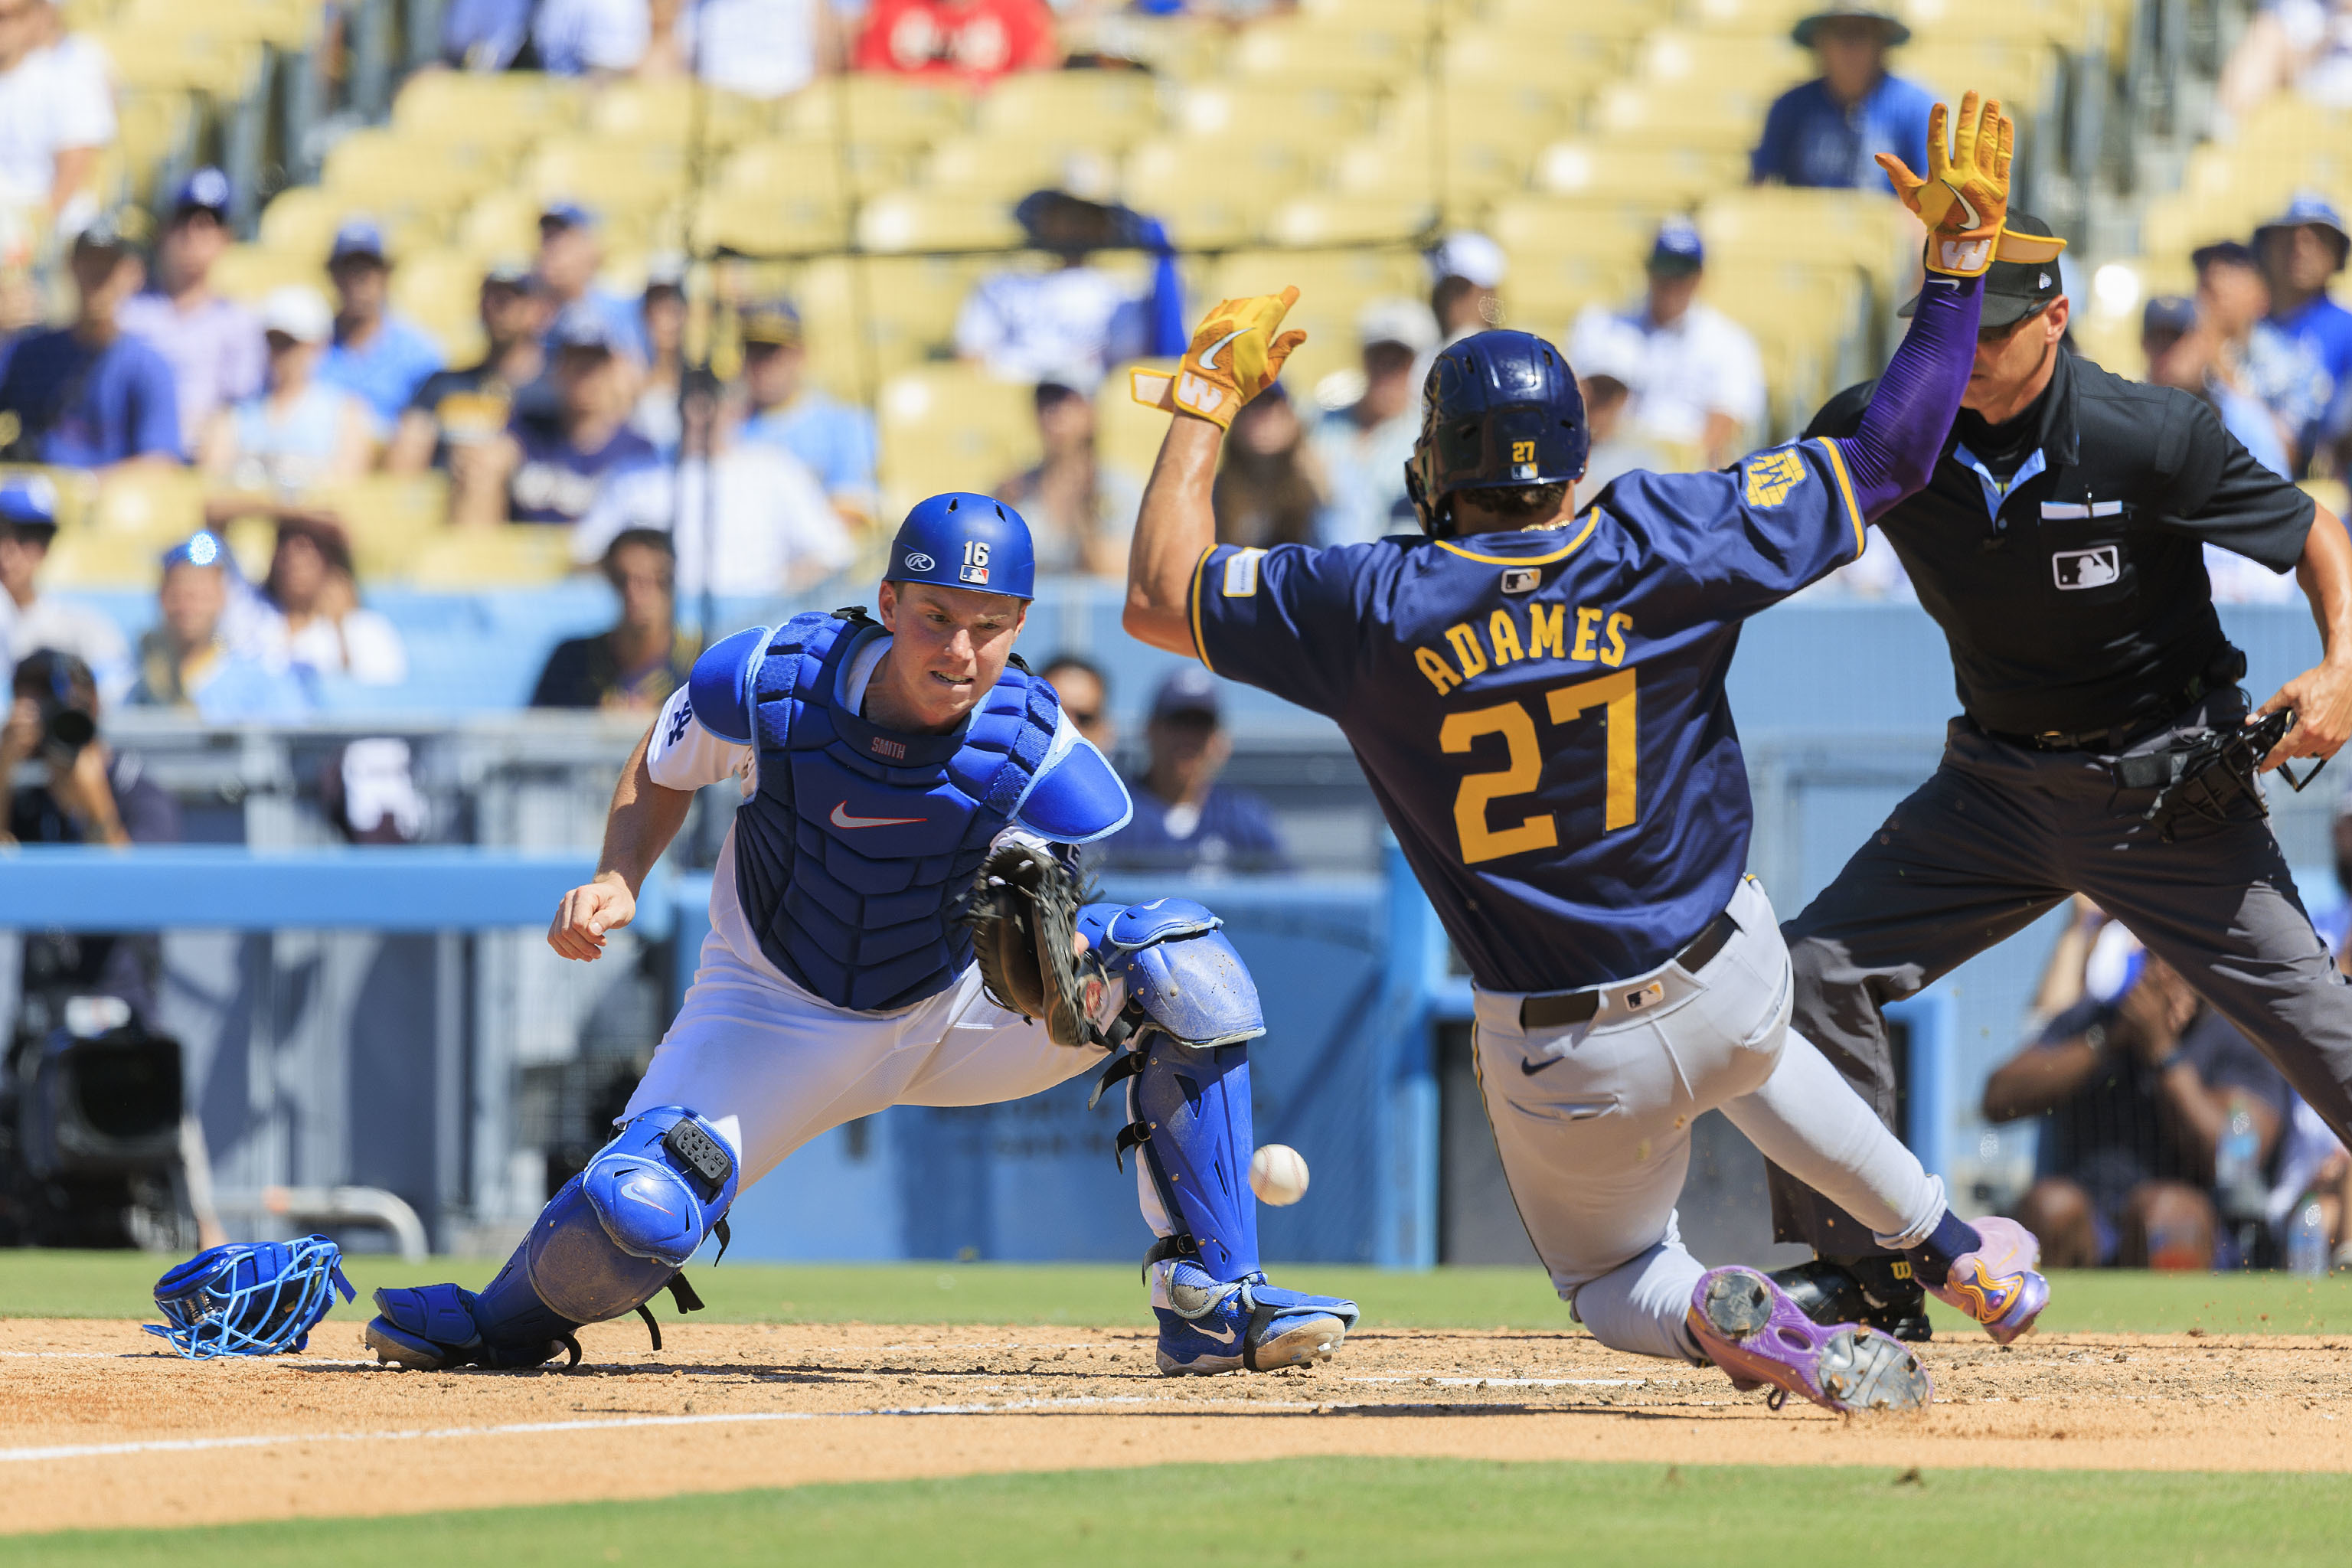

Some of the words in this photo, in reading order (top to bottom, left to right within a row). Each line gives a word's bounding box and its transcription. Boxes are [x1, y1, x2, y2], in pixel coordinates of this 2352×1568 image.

[1512, 441, 1535, 462] 27
[907, 554, 930, 570] R
[964, 540, 991, 567] 16
[1413, 603, 1634, 697] ADAMES
[871, 737, 906, 760] SMITH
[1439, 667, 1637, 864] 27
